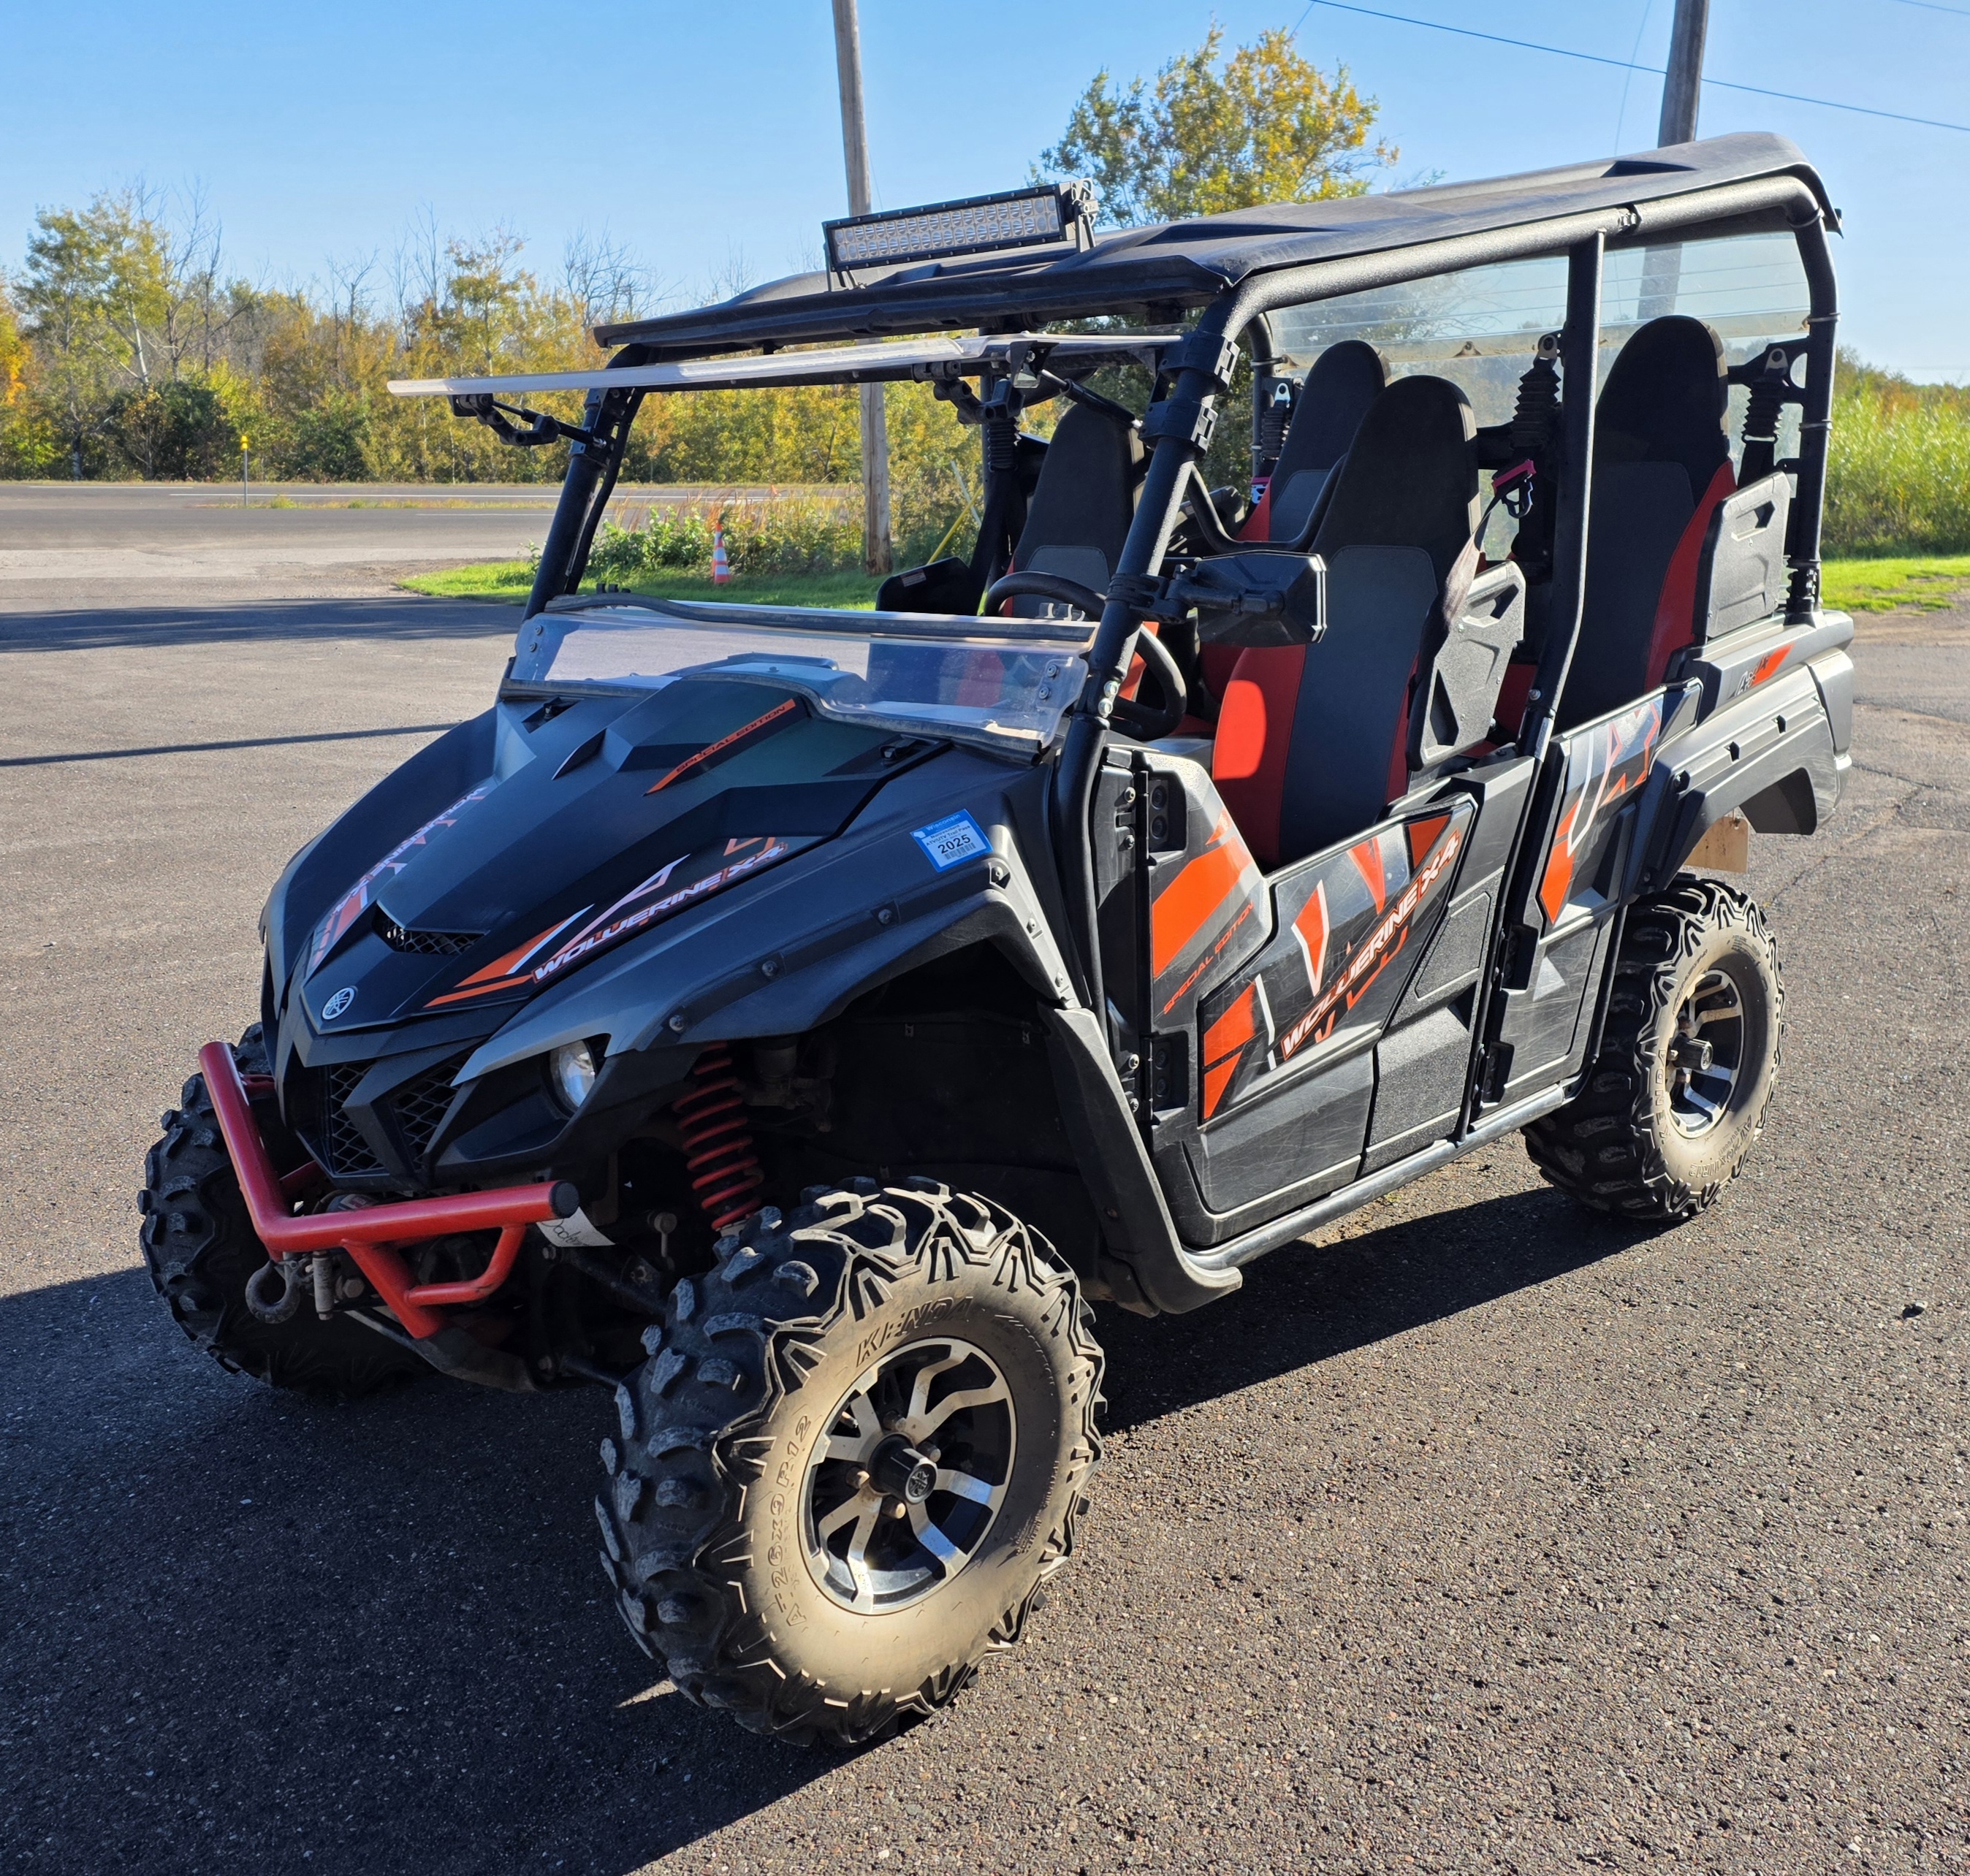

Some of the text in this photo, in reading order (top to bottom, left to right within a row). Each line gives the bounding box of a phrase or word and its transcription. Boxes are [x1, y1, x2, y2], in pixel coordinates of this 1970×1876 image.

[676, 706, 786, 773] SPECIAL EDITION
[925, 814, 961, 831] Wisconsin
[930, 825, 959, 839] Nonresident
[938, 834, 970, 854] 2025
[947, 829, 959, 837] Trail
[535, 843, 786, 980] WOLVERINE X4
[1282, 830, 1461, 1056] WOLVERINE X4
[1163, 899, 1255, 1014] SPECIAL EDITION
[856, 1295, 974, 1368] KENDA
